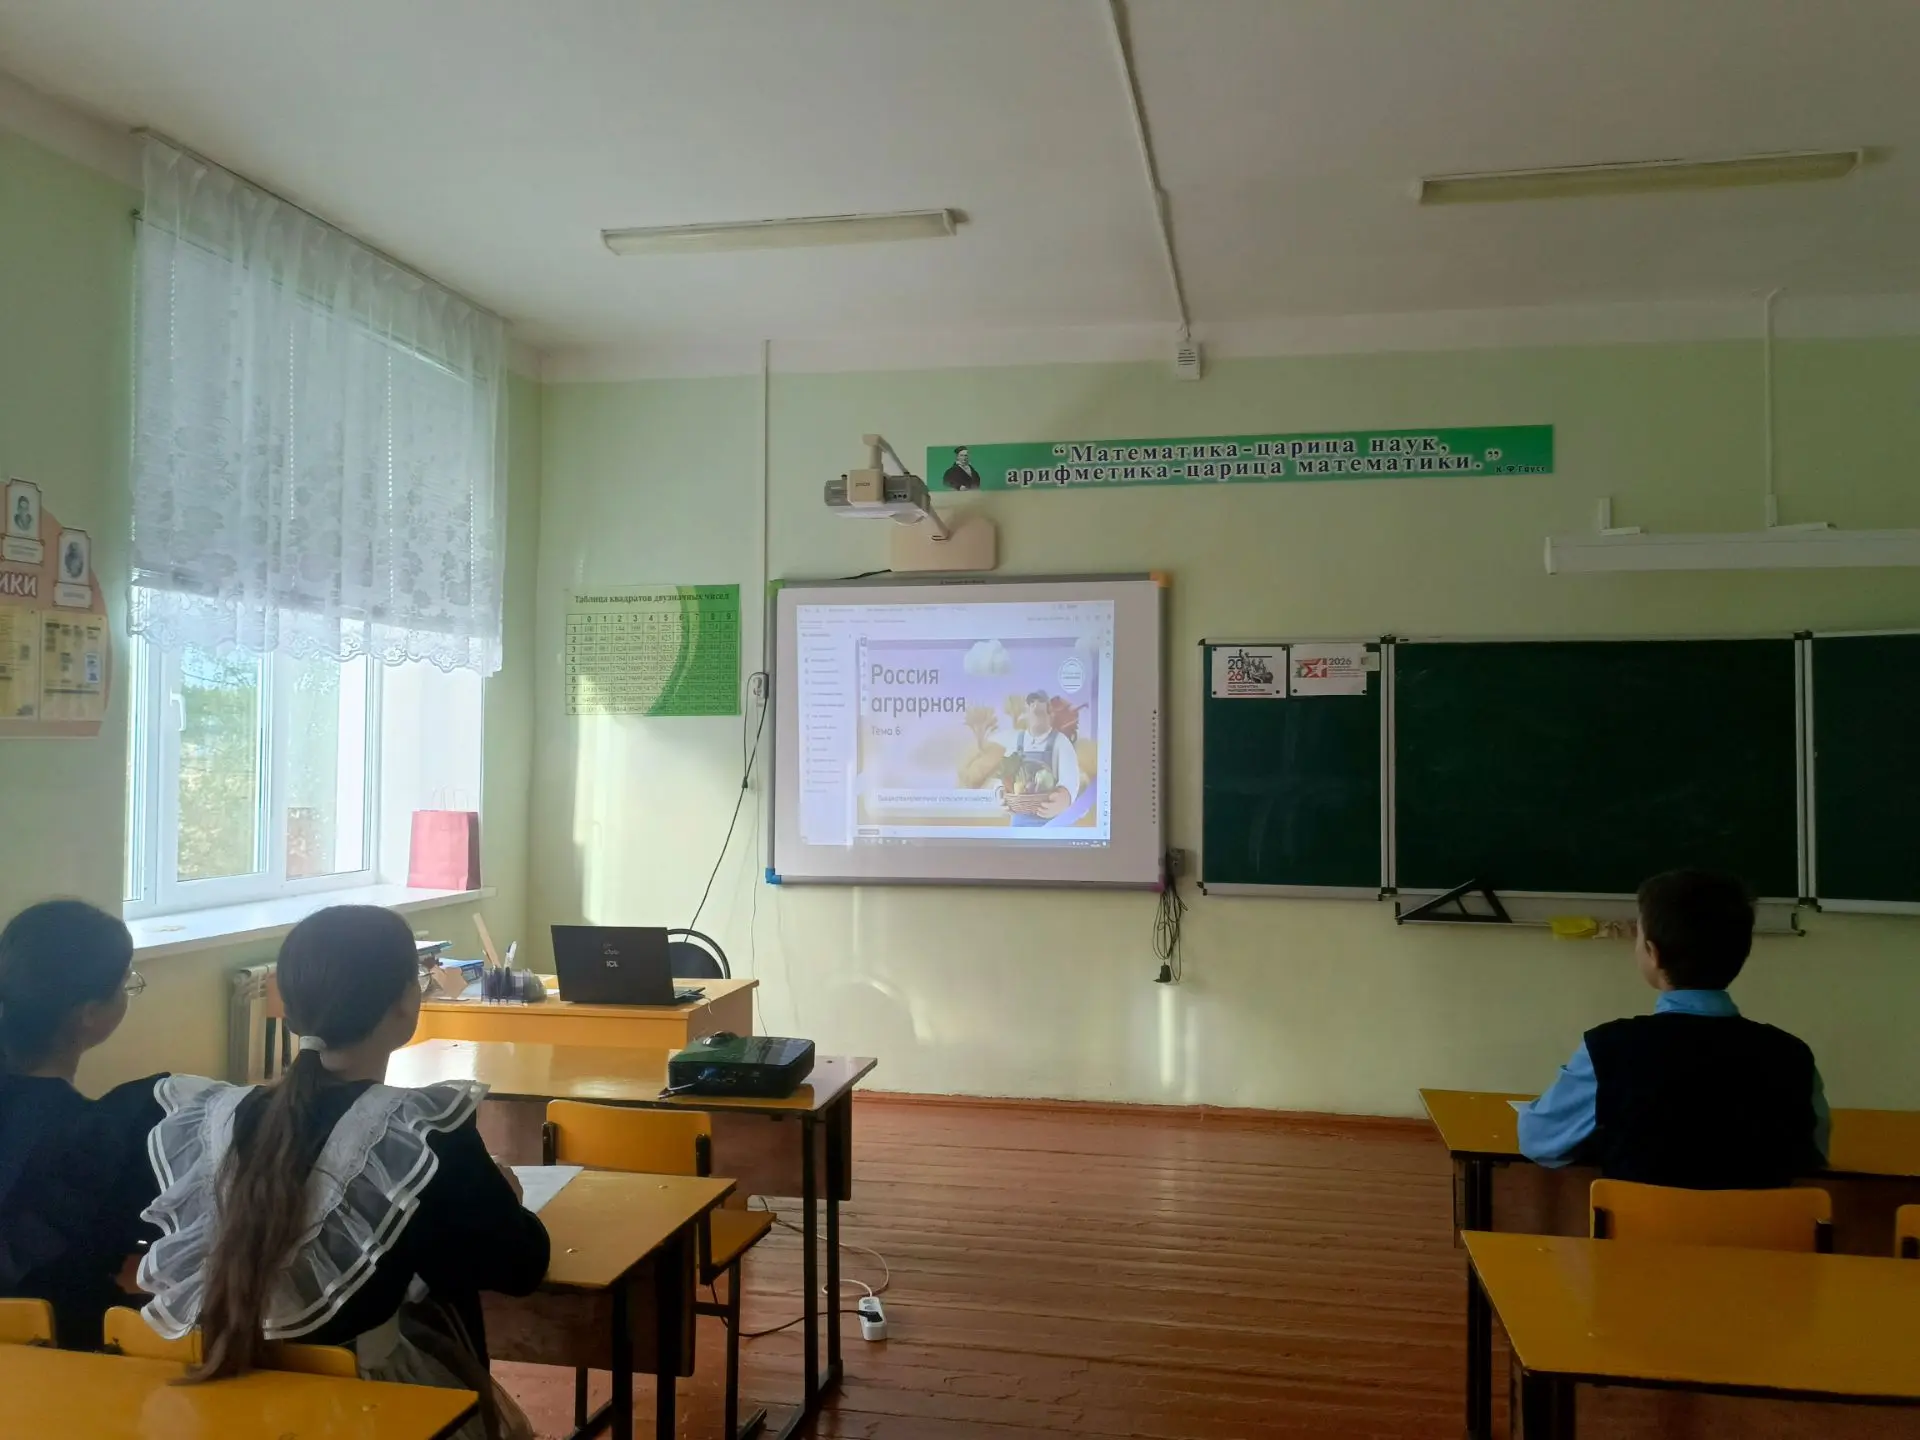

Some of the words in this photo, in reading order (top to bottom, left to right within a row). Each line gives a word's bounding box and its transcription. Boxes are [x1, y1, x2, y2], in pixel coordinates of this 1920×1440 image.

[1371, 436, 1448, 455] наук,
[1007, 461, 1282, 485] арифметика-царица
[574, 595, 608, 603] Таблица
[609, 595, 652, 604] квадратов
[1227, 658, 1243, 670] 20
[1328, 657, 1352, 666] 2026
[871, 664, 939, 685] Россия
[1227, 670, 1244, 681] 26
[871, 695, 966, 718] аграрная
[871, 727, 893, 737] Тема
[895, 726, 902, 736] 6
